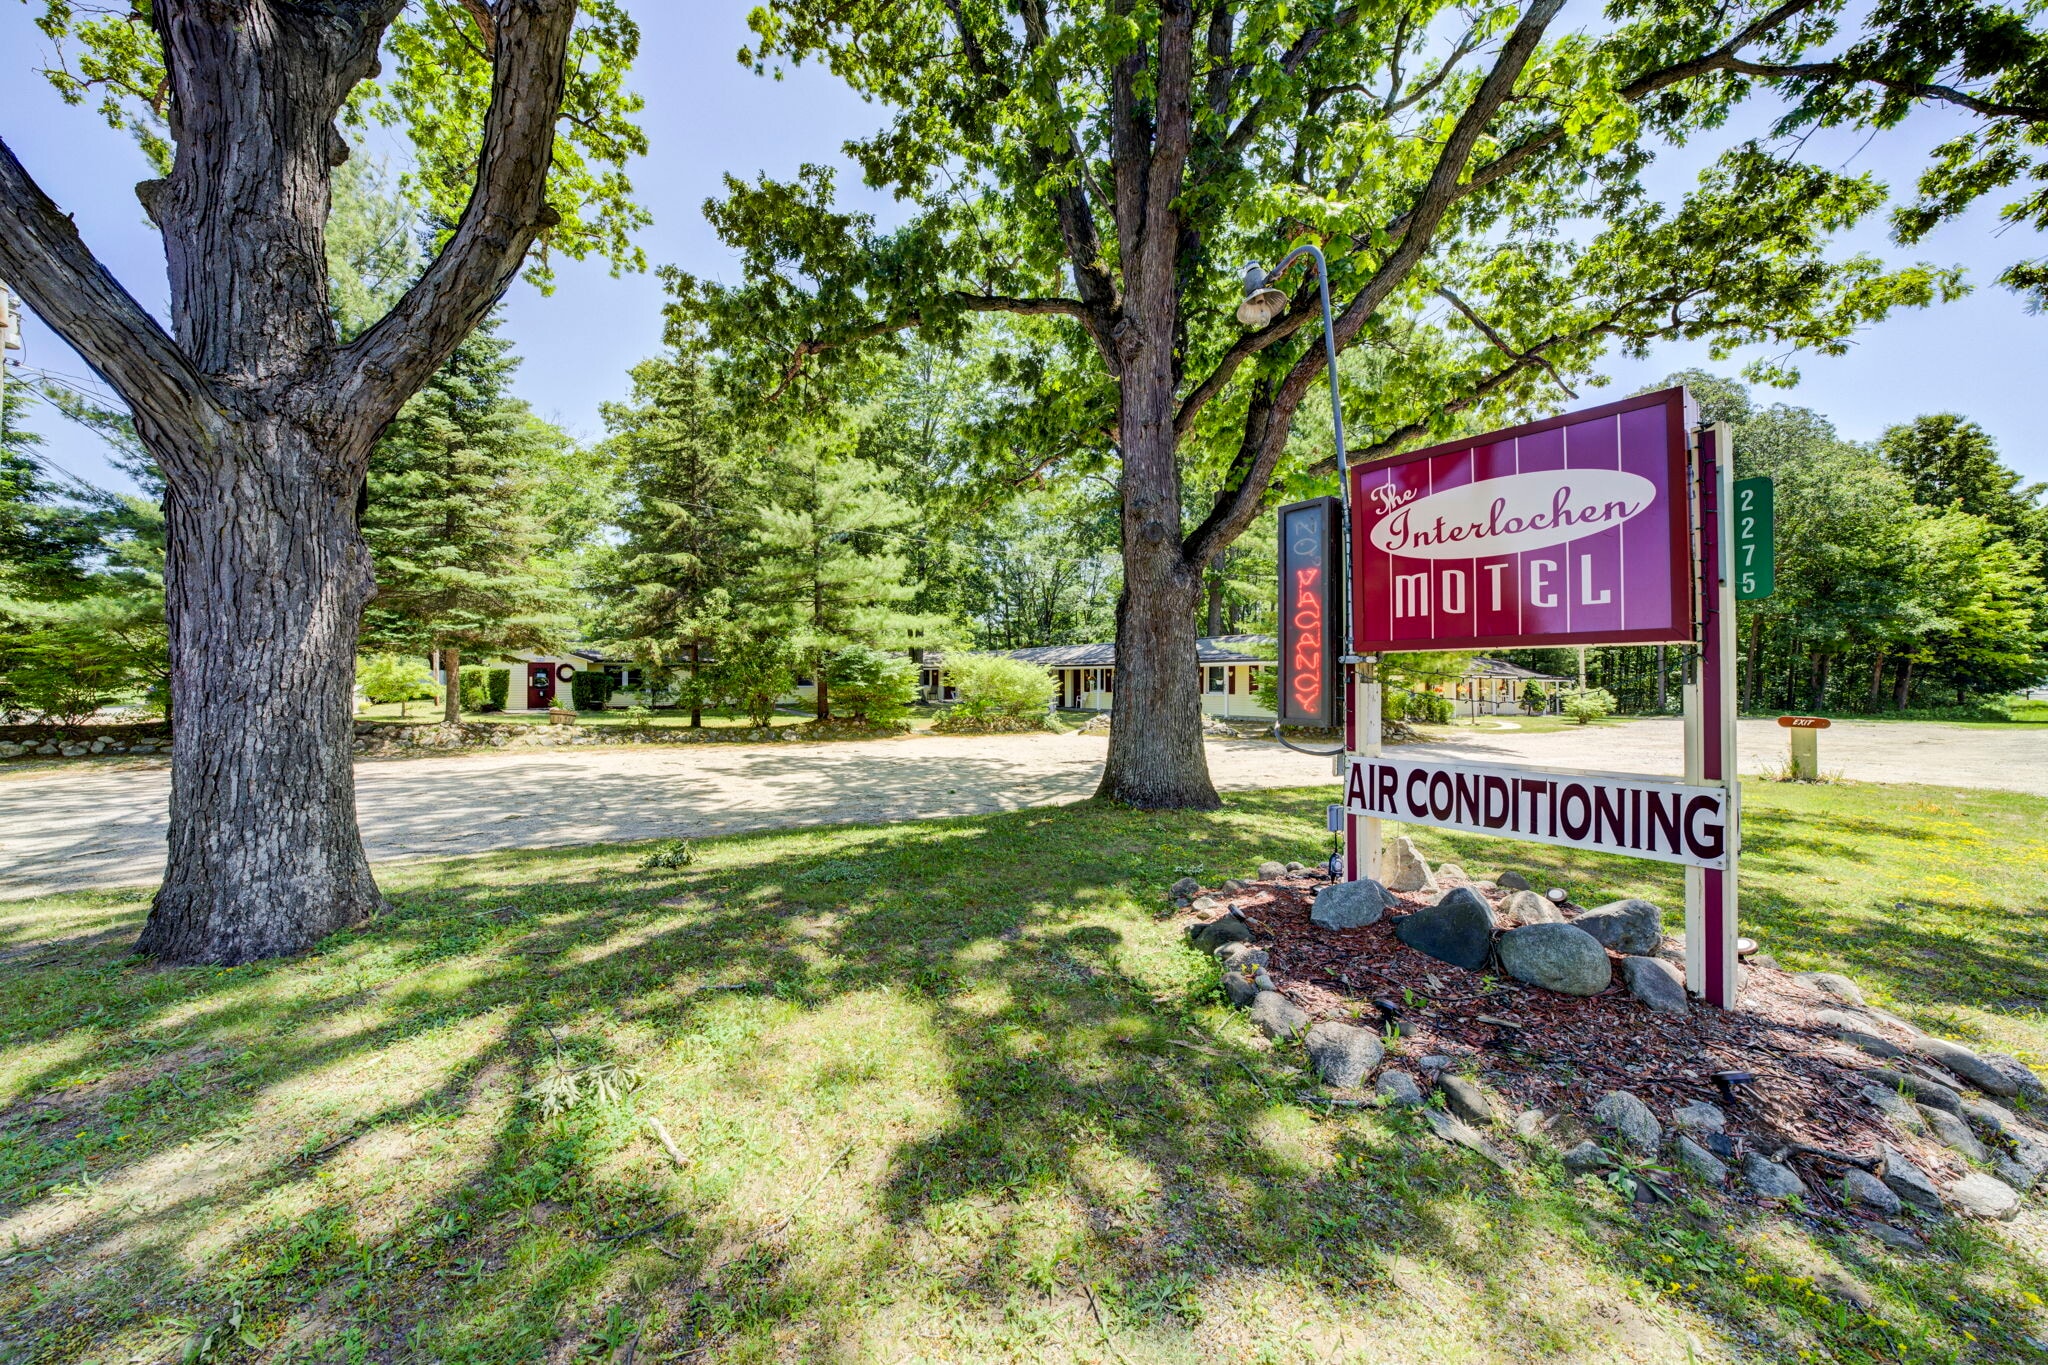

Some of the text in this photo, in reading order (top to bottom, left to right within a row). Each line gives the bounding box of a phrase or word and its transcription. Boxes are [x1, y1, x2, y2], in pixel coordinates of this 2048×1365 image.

[1371, 481, 1417, 515] The
[1386, 486, 1640, 551] Interlochen
[1294, 516, 1319, 557] NO
[1740, 489, 1756, 594] 2275
[1395, 554, 1611, 618] MOTEL
[1295, 568, 1321, 713] VACANCY
[1347, 762, 1724, 859] AIR CONDITIONING
